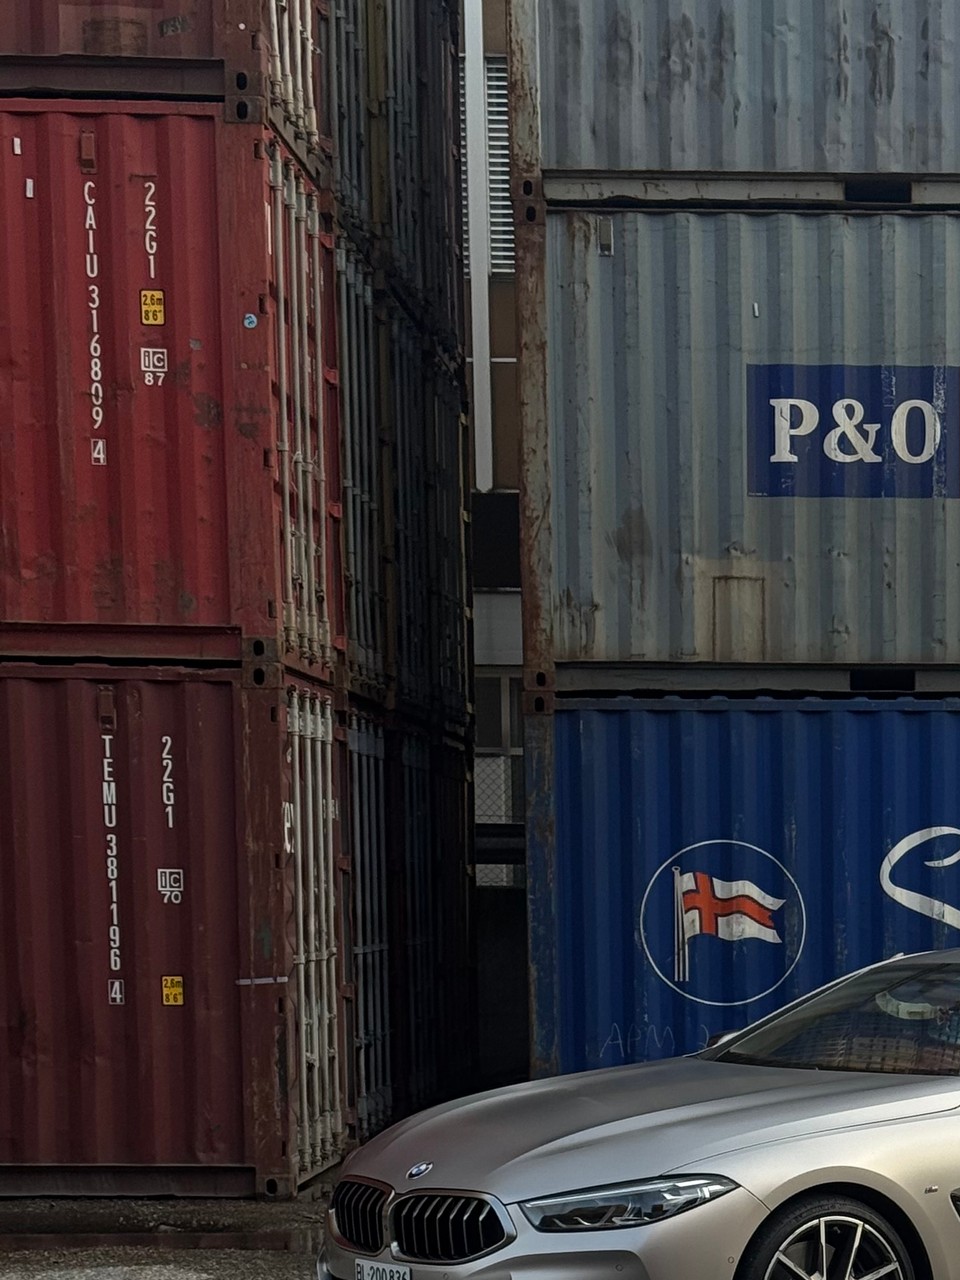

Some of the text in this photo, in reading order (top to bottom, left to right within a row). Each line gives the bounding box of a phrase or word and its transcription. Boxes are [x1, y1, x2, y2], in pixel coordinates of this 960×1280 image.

[144, 182, 157, 278] 22G1
[84, 181, 106, 464] CAIU 316809 4
[144, 372, 166, 386] 87
[769, 398, 941, 464] P&O
[161, 736, 175, 829] 22G1
[101, 735, 123, 1004] TEMU 381196 4
[161, 891, 182, 904] 70
